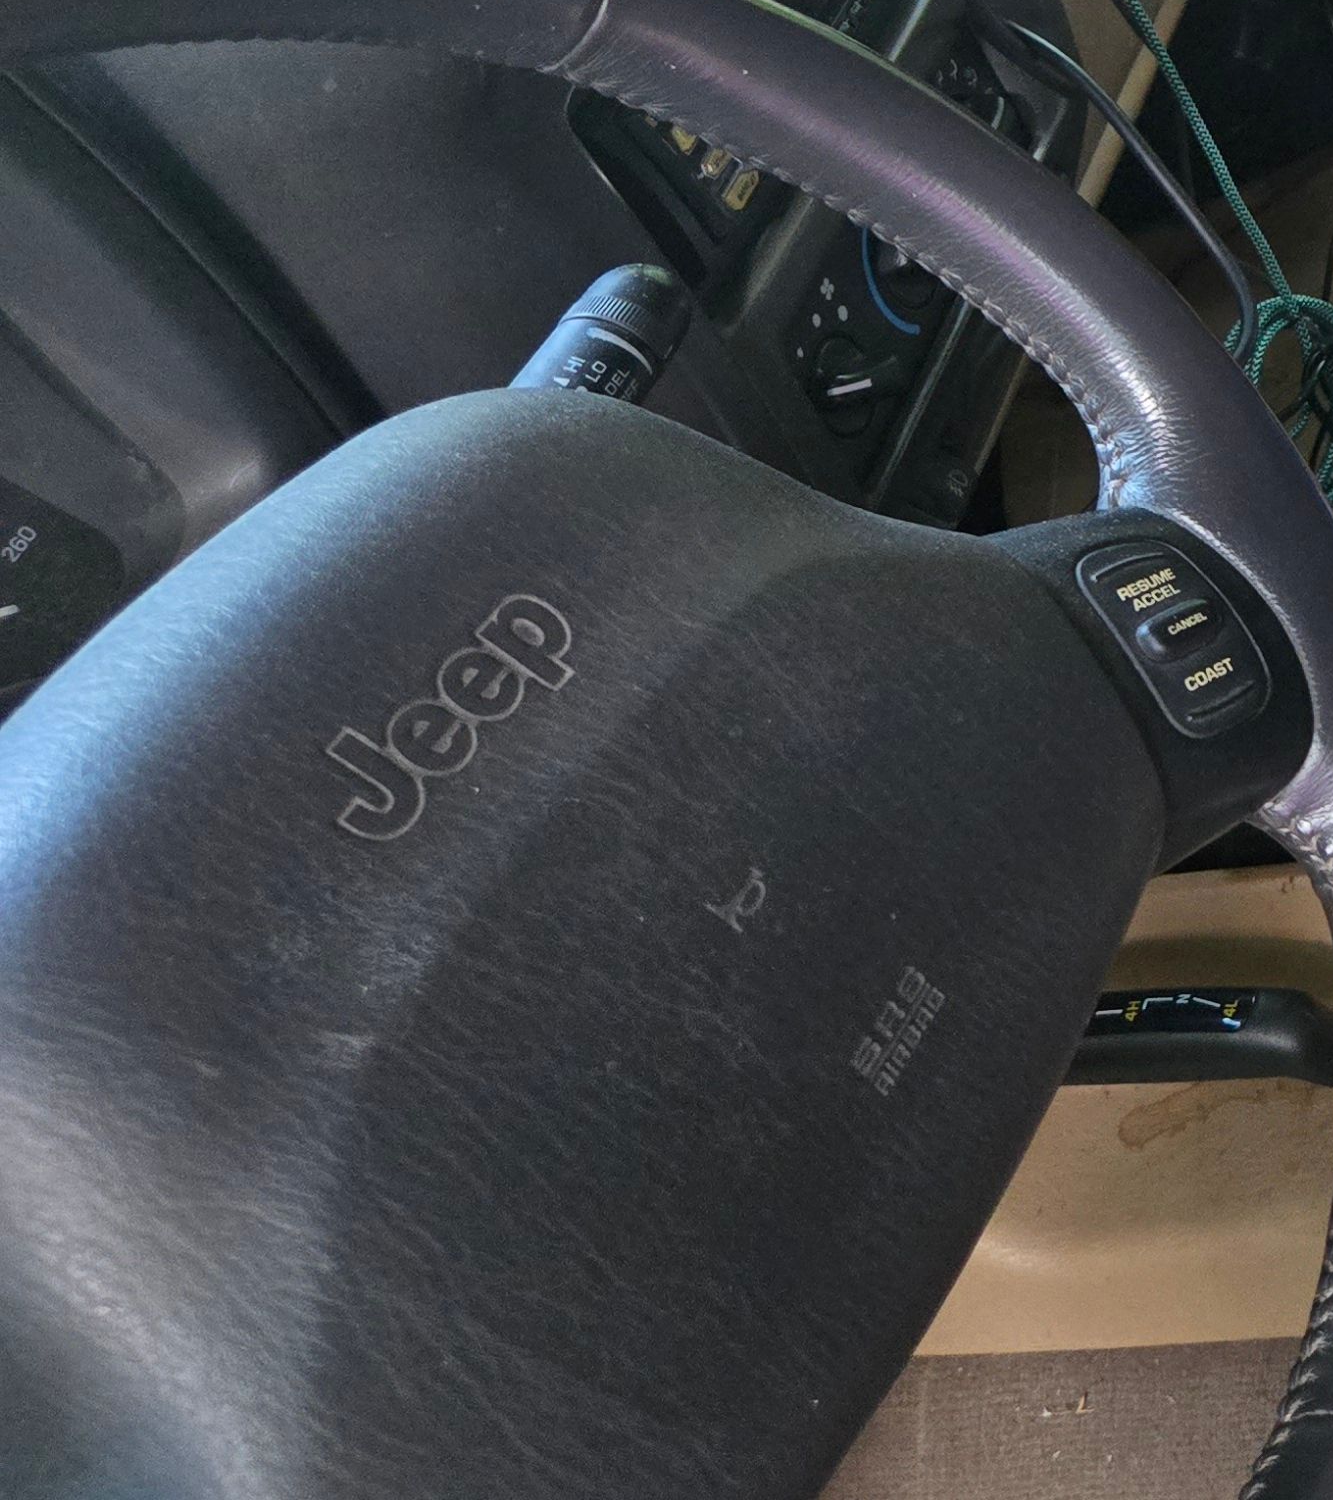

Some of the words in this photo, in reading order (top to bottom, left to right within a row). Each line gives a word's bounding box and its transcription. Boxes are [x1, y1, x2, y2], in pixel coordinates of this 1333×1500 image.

[563, 355, 586, 374] HI
[584, 360, 608, 384] LO
[604, 368, 631, 396] DEL
[0, 525, 38, 563] 260
[1116, 567, 1177, 602] RESUME
[1132, 583, 1182, 613] ACCEL
[1167, 611, 1208, 636] CANCEL
[1183, 657, 1235, 693] COAST
[326, 594, 576, 841] Jeep
[1124, 1000, 1142, 1023] 4H
[1175, 993, 1193, 1004] N
[1222, 999, 1240, 1018] 4L
